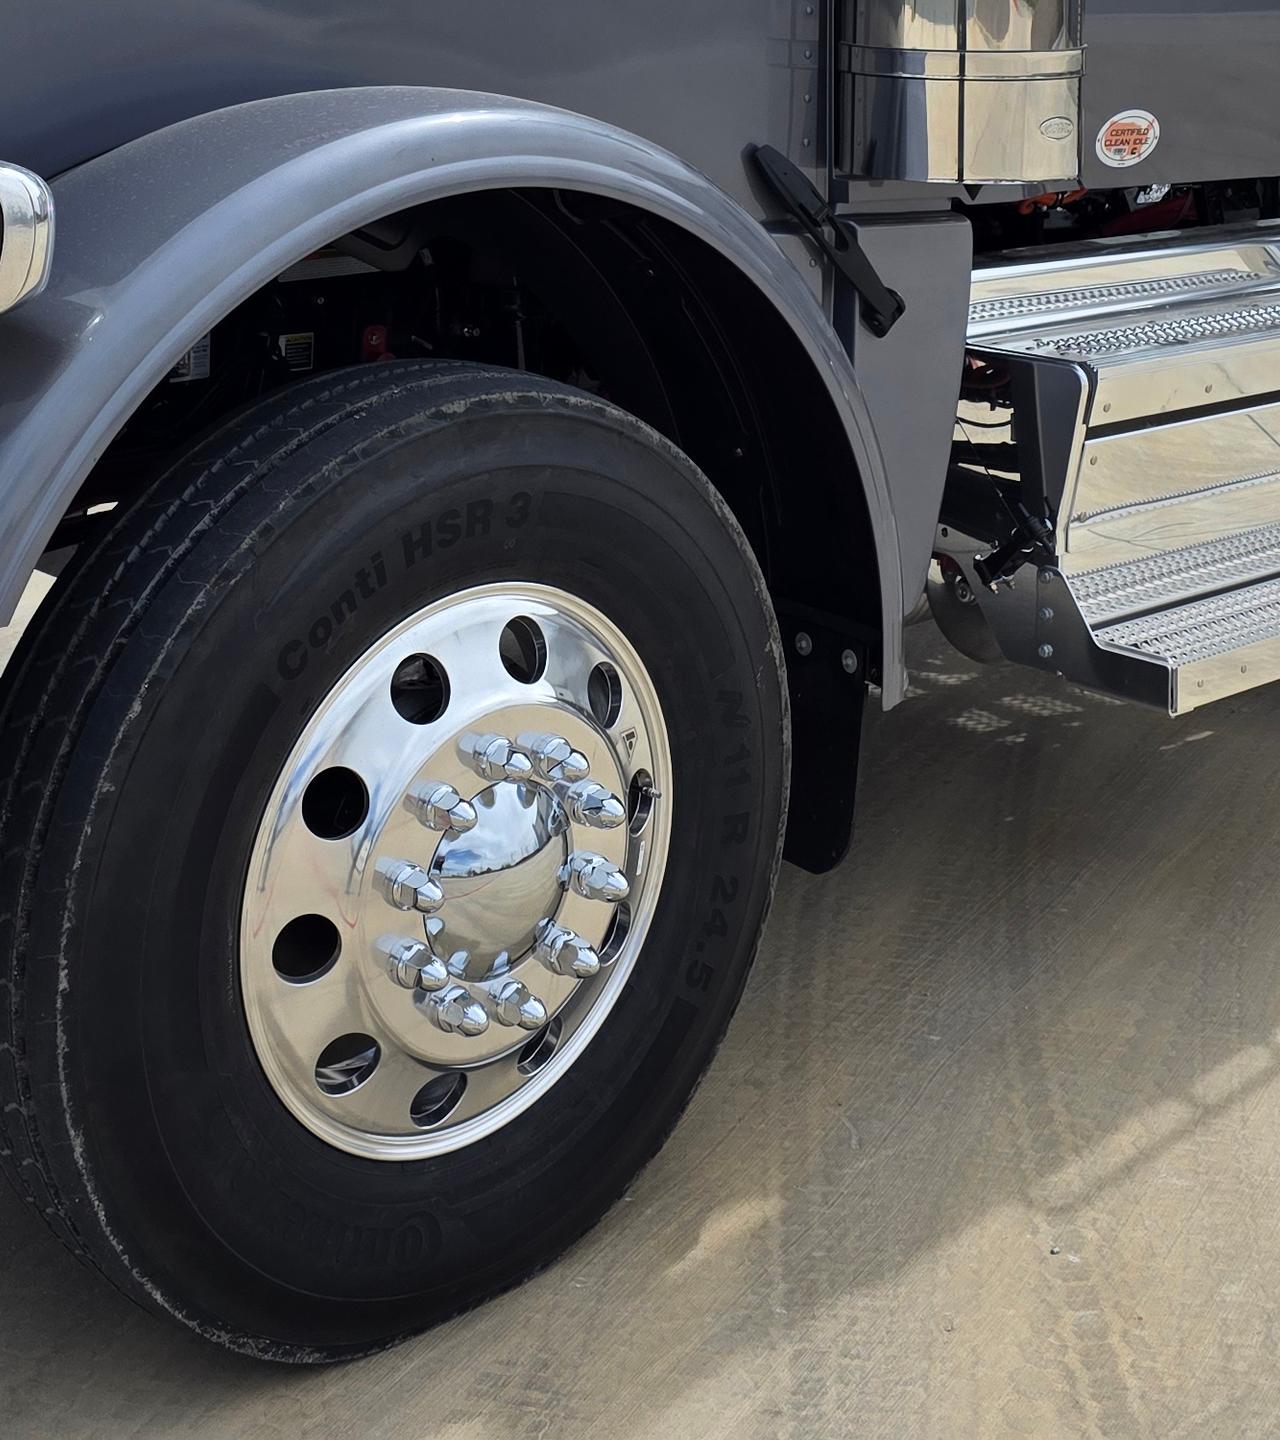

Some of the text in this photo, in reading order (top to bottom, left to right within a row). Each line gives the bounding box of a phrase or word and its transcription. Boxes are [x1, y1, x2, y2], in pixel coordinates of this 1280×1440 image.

[1110, 127, 1150, 137] CERTIFIED
[1104, 137, 1150, 147] CLEAN IDLE
[277, 490, 533, 681] Conti HSR 3
